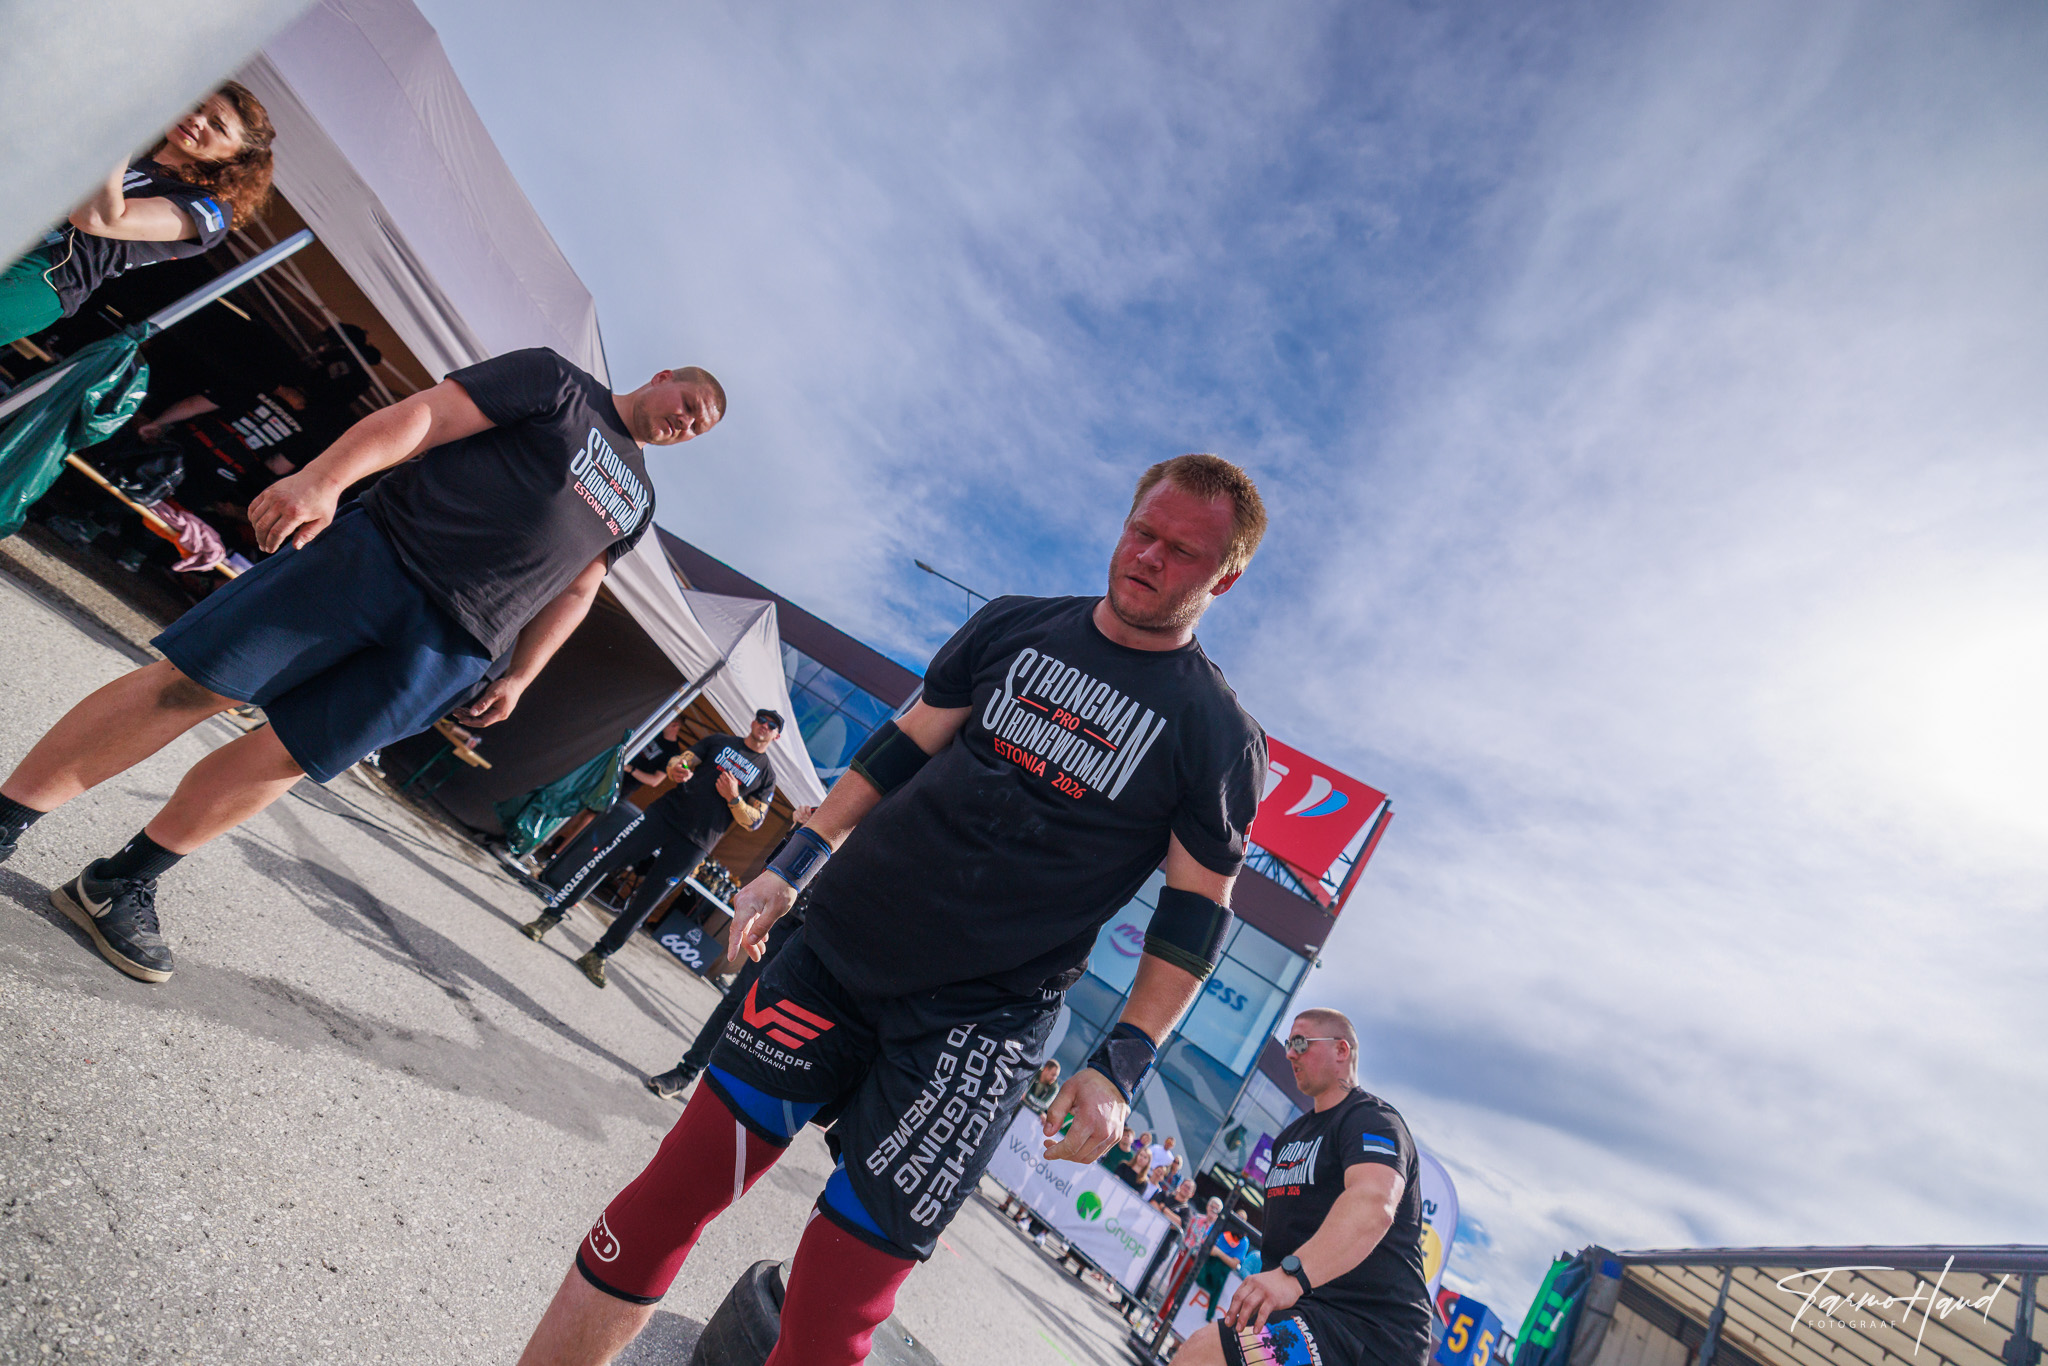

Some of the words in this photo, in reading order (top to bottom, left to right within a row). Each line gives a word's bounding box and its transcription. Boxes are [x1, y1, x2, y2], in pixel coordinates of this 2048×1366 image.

[573, 481, 607, 520] ESTONIA
[606, 517, 621, 536] 2026
[609, 478, 623, 496] PRO
[998, 648, 1167, 768] STRONGMAN
[1051, 708, 1080, 731] PRO
[982, 688, 1148, 800] STRONGWOMAN
[994, 737, 1046, 778] ESTONIA
[1051, 771, 1087, 800] 2026
[587, 813, 646, 869] ARMLIFTING
[549, 865, 591, 908] ESTONIA
[725, 1032, 740, 1046] MADE
[740, 1042, 748, 1050] IN
[748, 1046, 787, 1072] LITHUANIA
[754, 1040, 814, 1071] EUROPE
[946, 1023, 978, 1048] TO
[956, 1034, 998, 1099] FOR
[866, 1051, 959, 1176] EXTREMES
[910, 1039, 1024, 1227] WATCHES
[893, 1096, 968, 1195] GOING
[1008, 1134, 1073, 1198] Woodwell
[1104, 1217, 1147, 1259] Grupp
[1447, 1313, 1474, 1354] 5
[1473, 1329, 1494, 1366] 5
